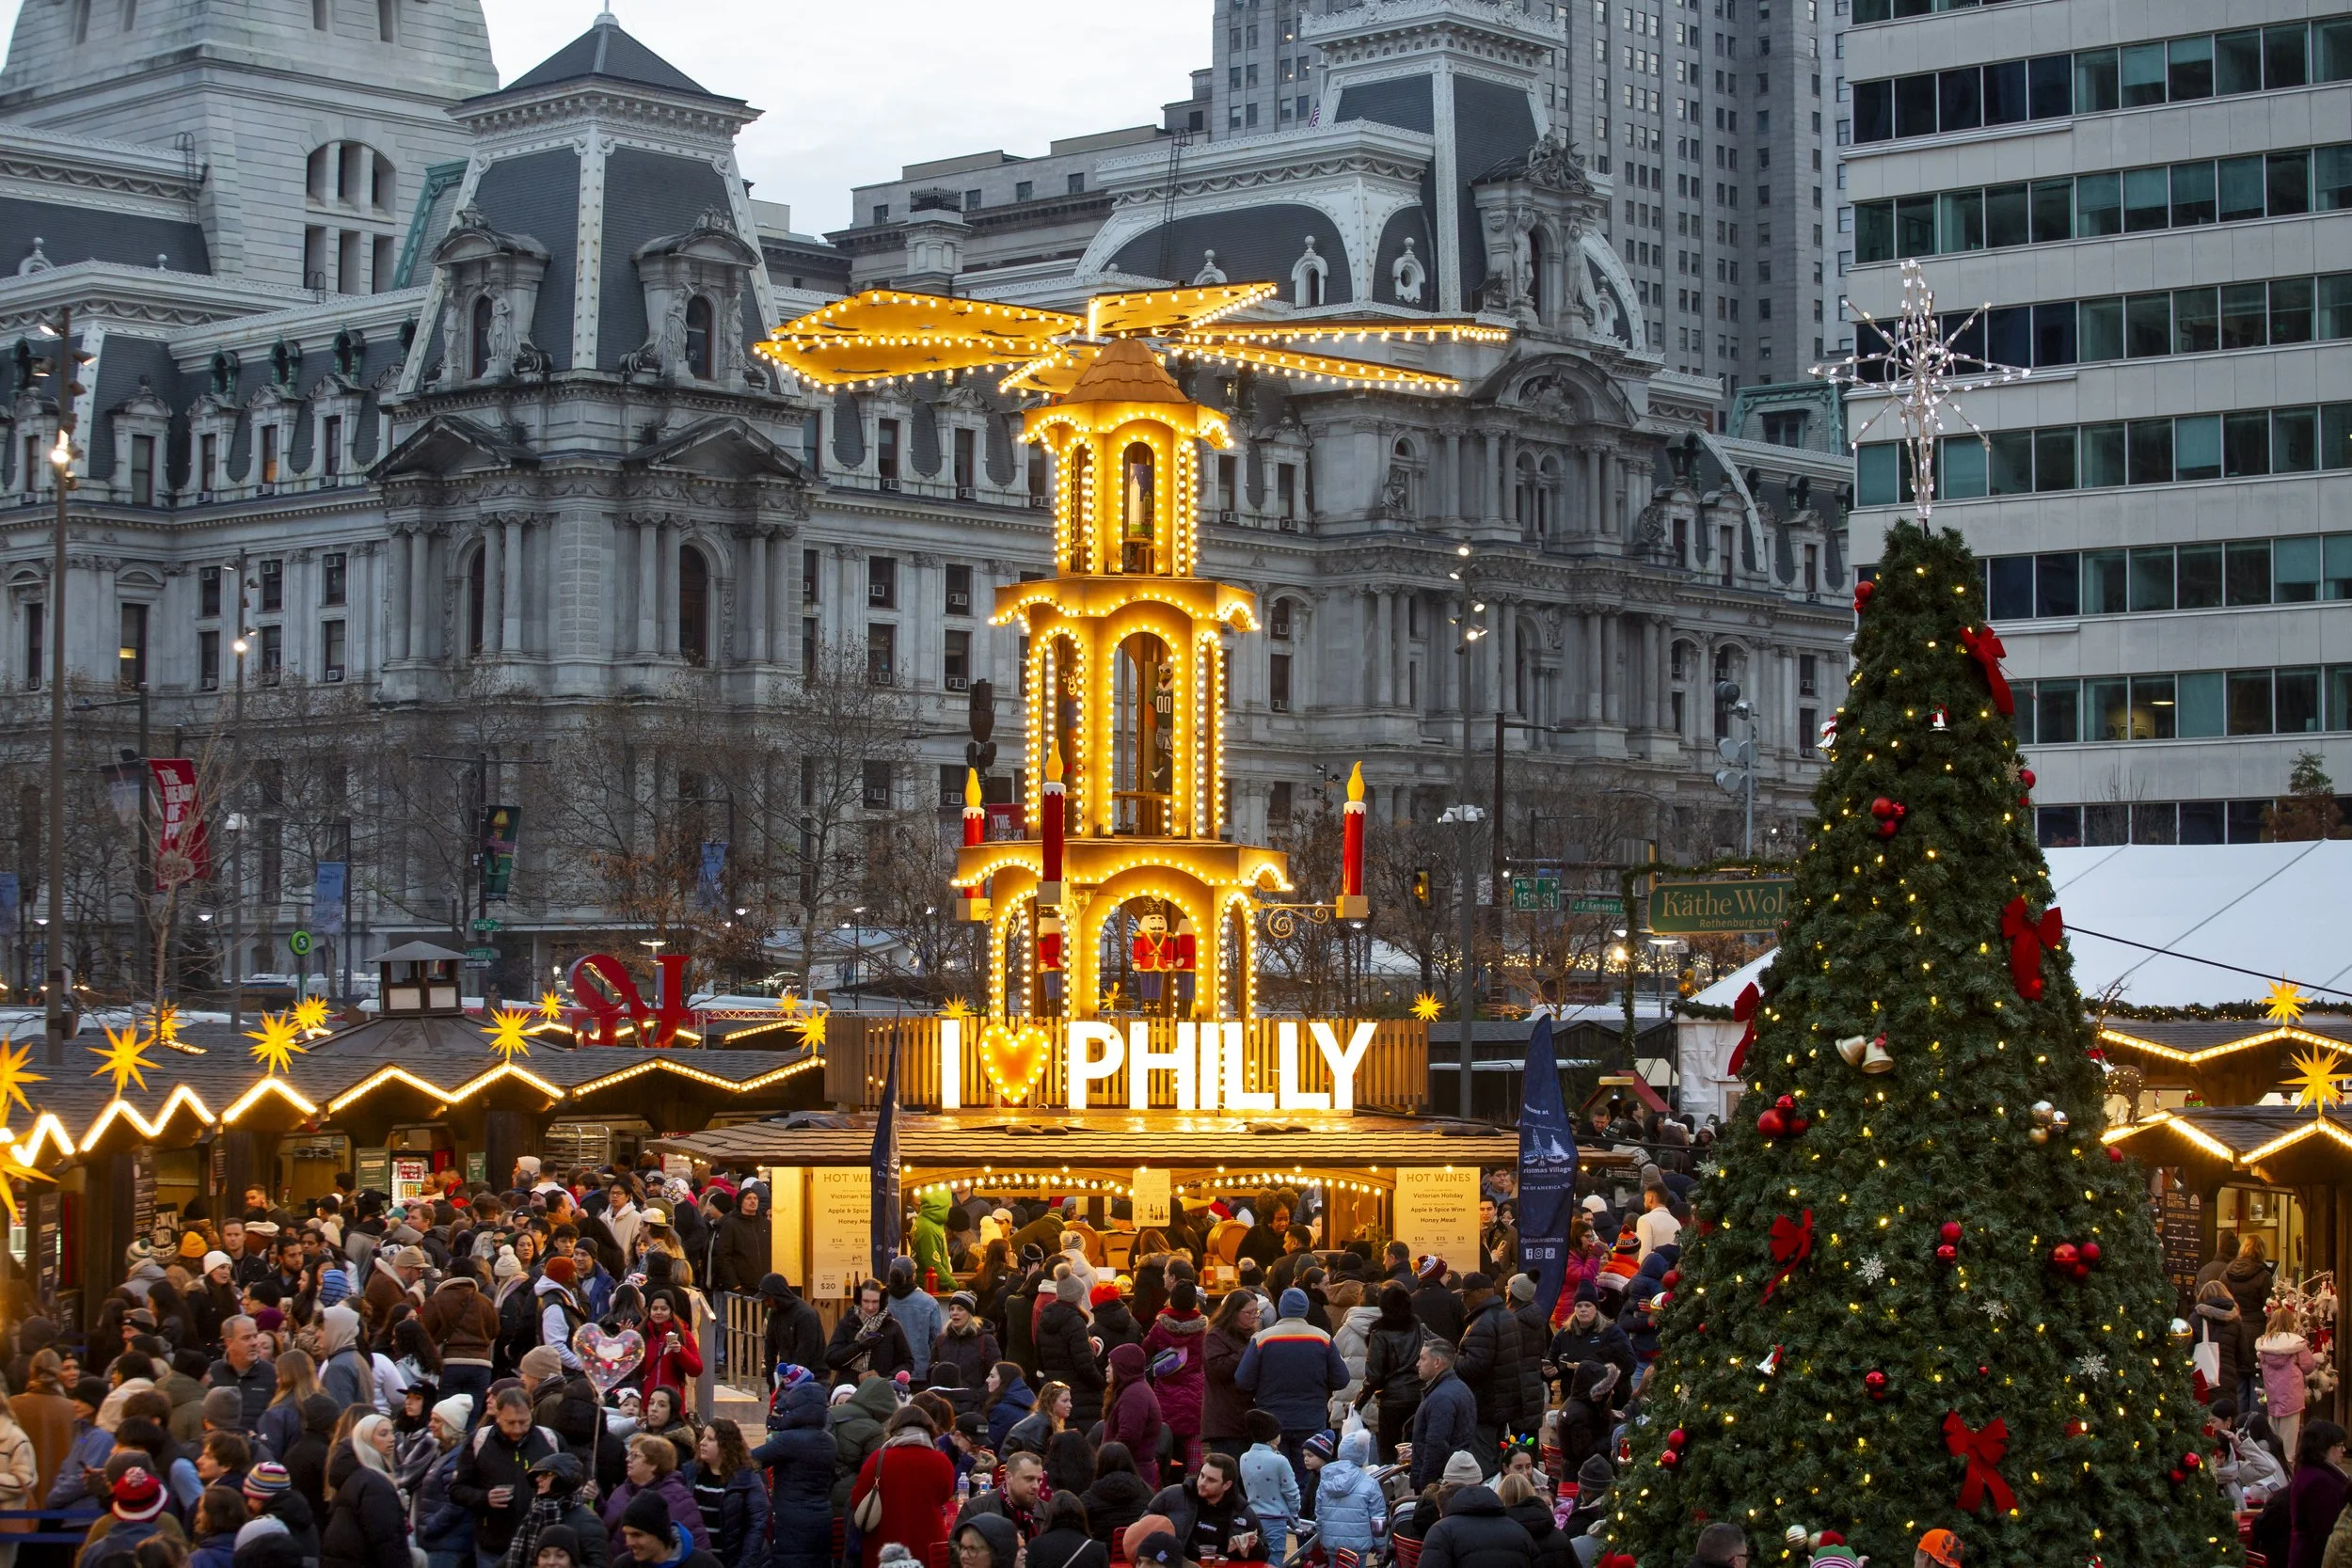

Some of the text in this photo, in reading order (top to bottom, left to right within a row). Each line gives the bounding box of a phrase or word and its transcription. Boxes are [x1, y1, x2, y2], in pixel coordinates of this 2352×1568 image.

[157, 769, 182, 784] THE
[167, 804, 181, 822] OF
[993, 815, 1011, 829] THE
[1588, 902, 1617, 911] Kennedy
[1661, 889, 1732, 917] Käthe
[1699, 917, 1755, 928] Rothenburg
[1757, 917, 1770, 927] ob
[942, 1020, 1378, 1110] I PHILLY
[1549, 1165, 1572, 1175] Village
[823, 1174, 850, 1182] HOT
[1406, 1173, 1471, 1182] HOT WINES
[1198, 1521, 1218, 1531] Supreme
